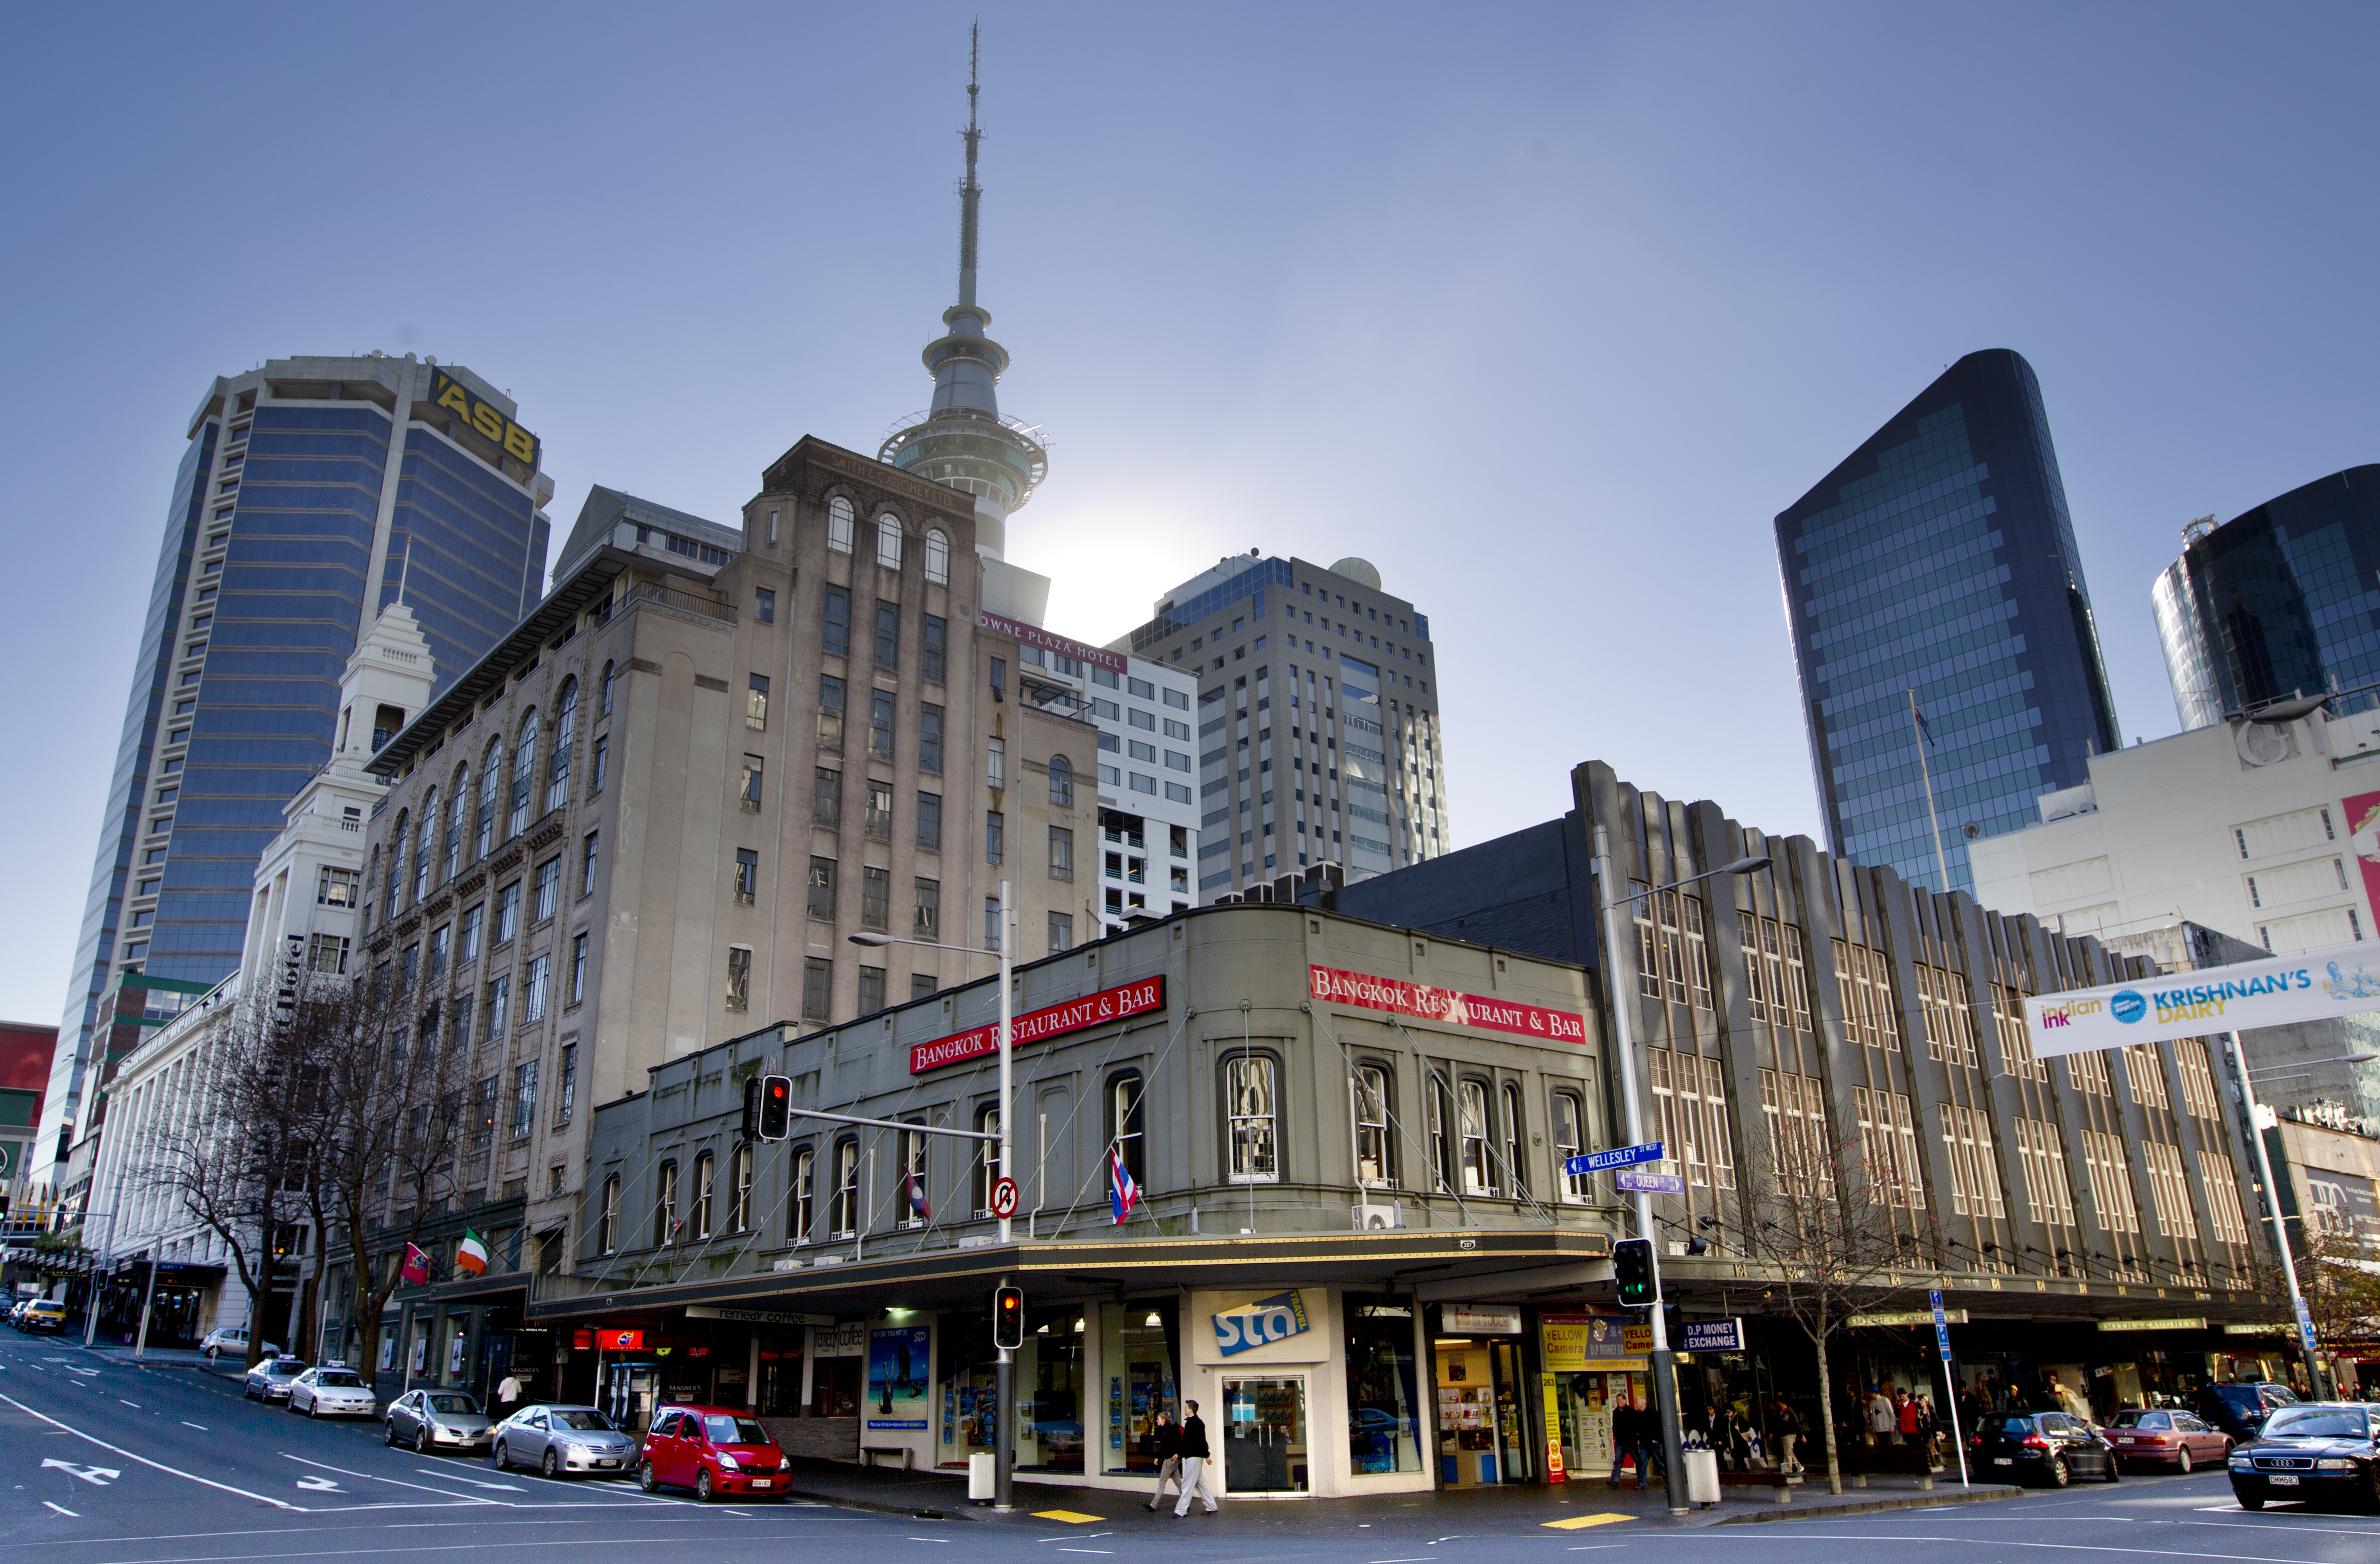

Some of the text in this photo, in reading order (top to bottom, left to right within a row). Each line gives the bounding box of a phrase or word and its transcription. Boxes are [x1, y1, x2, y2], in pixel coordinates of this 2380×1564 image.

[436, 378, 534, 464] ASB
[831, 454, 865, 476] SMITH
[877, 471, 930, 499] CAUGHEY
[1077, 646, 1120, 668] HOTEL
[2152, 969, 2312, 1011] KRISHNAN'S
[1312, 969, 1582, 1037] BANGKOK RESTAURANT & BAR
[2041, 998, 2103, 1020] indian
[2158, 996, 2228, 1025] DAIRY
[915, 985, 1156, 1070] BANGKOK RSTAURANT & BAR
[2042, 1011, 2071, 1029] ink
[1587, 1148, 1636, 1169] WELLESLEY
[1645, 1143, 1657, 1152] WEST
[1636, 1174, 1658, 1188] QUEEN
[720, 1309, 805, 1323] remedy coffee
[1290, 1291, 1307, 1330] TRAVEL
[1482, 1314, 1509, 1327] TOUCH
[1216, 1306, 1296, 1347] sta
[1688, 1322, 1733, 1336] D.P MONEY
[2144, 1320, 2201, 1328] CAUGHEY'S
[2226, 1325, 2256, 1333] SMITH
[839, 1324, 863, 1346] coffee
[1545, 1329, 1583, 1340] YELLOW
[1689, 1335, 1736, 1349] EXCHANGE
[1547, 1342, 1584, 1354] Camera
[1599, 1344, 1617, 1355] MONEY
[1543, 1379, 1555, 1387] 263
[1598, 1417, 1607, 1459] SCAN
[1362, 1463, 1373, 1471] THE
